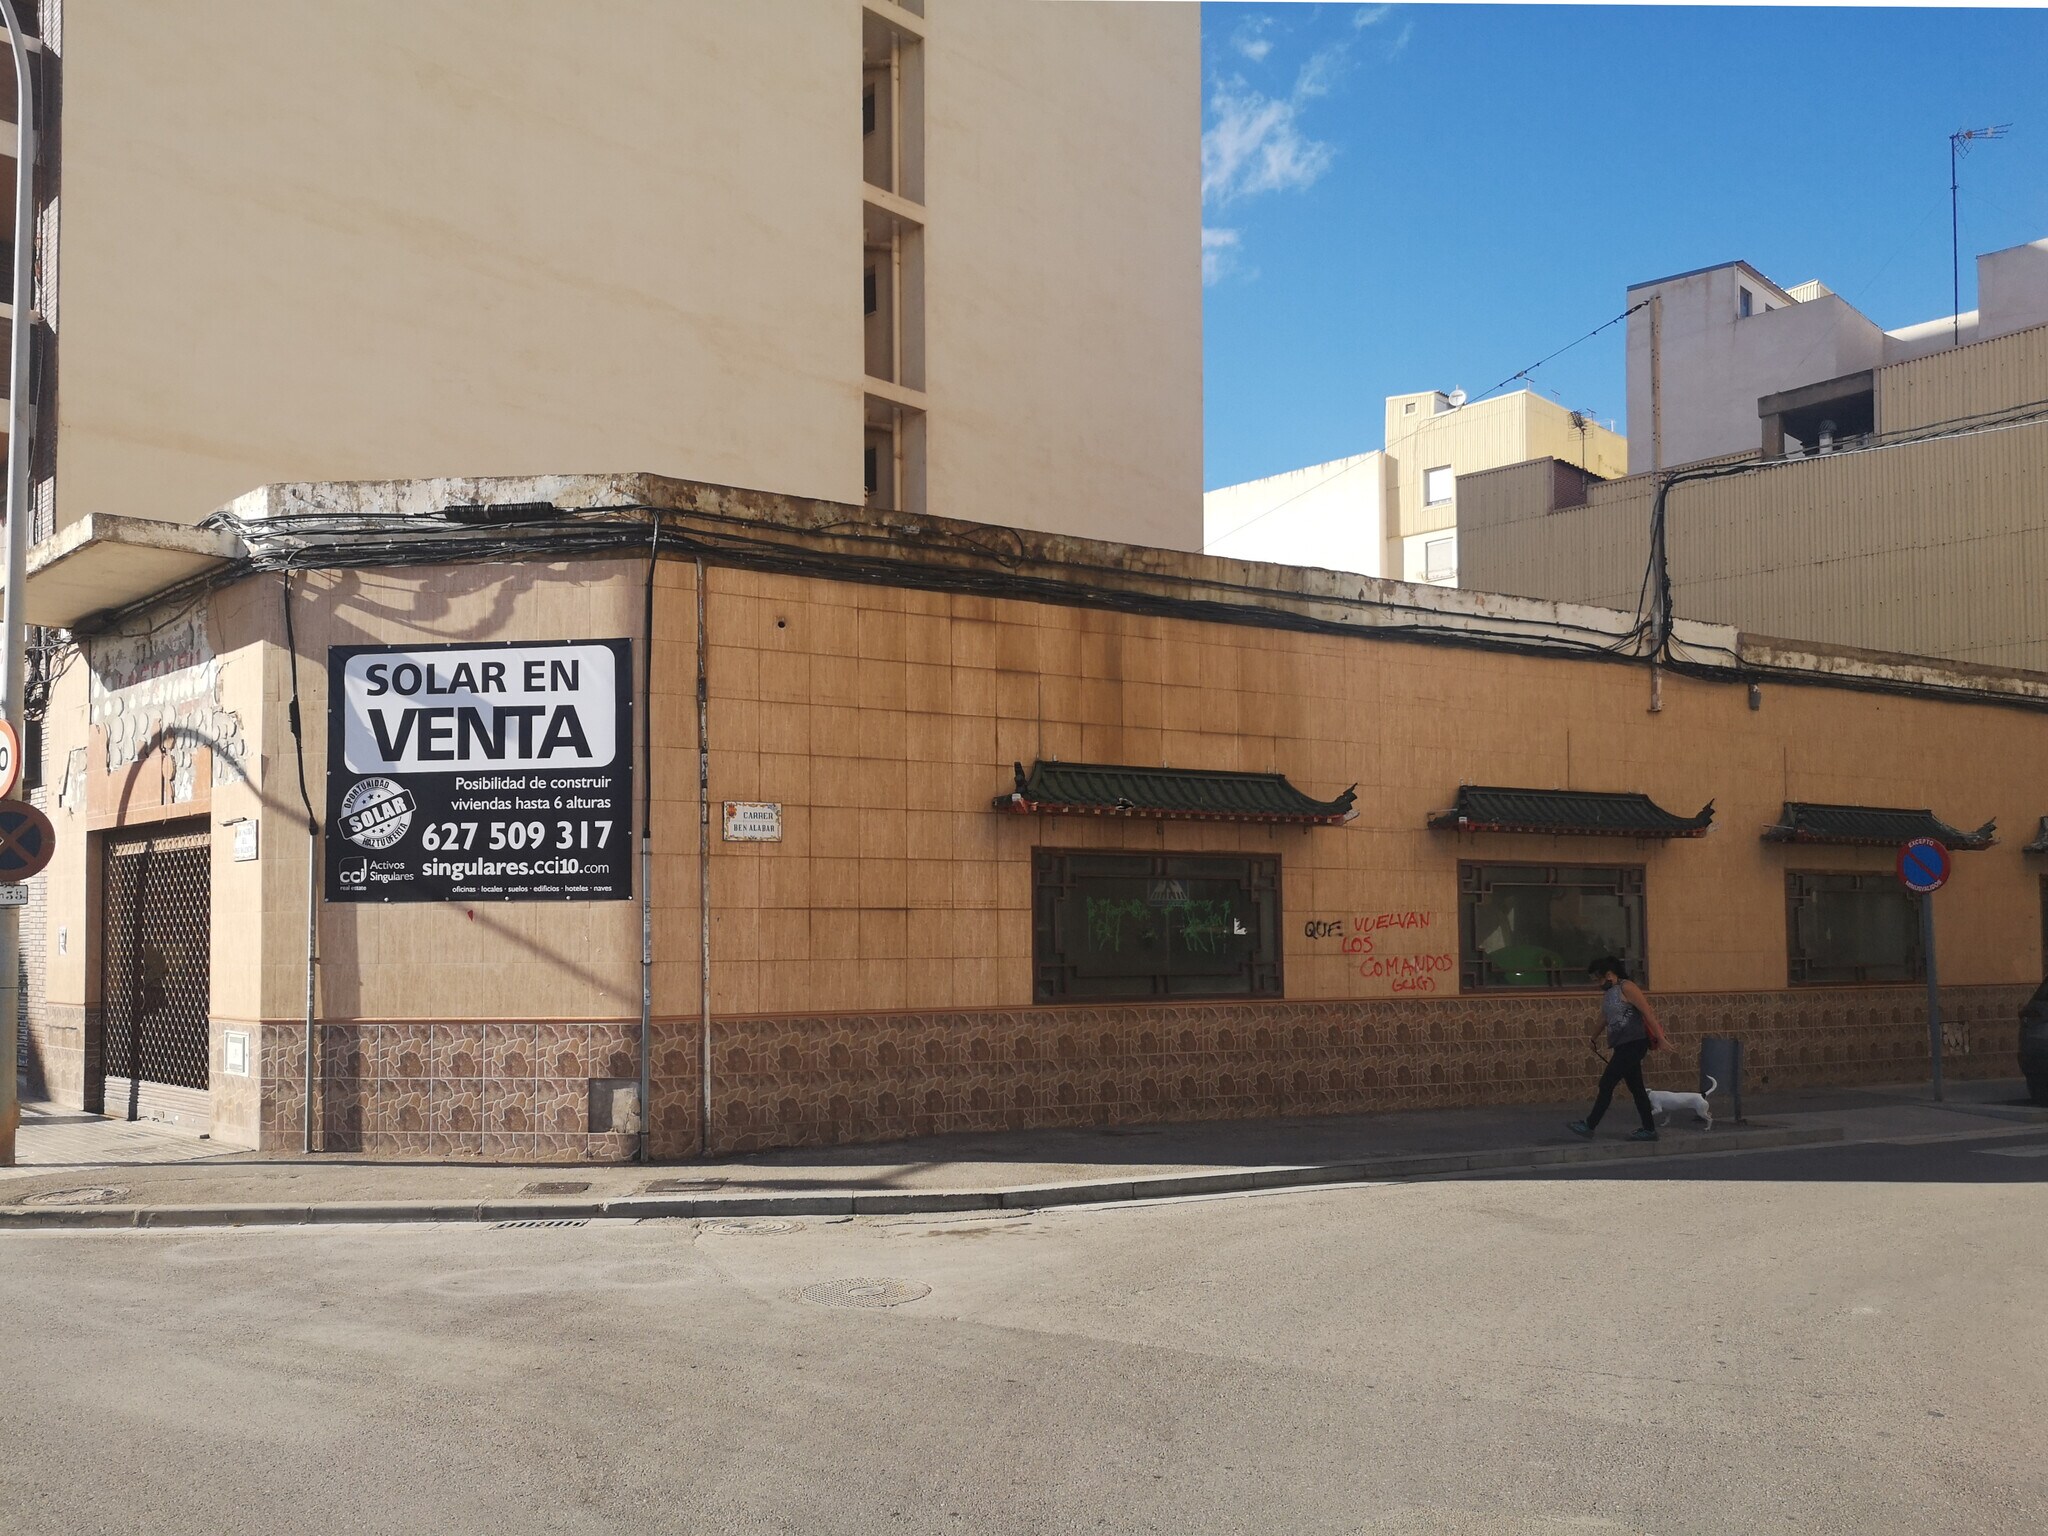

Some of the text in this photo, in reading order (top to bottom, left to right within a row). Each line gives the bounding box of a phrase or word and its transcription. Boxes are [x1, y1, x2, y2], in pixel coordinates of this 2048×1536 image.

[366, 660, 579, 696] SOLAR EN
[367, 705, 593, 762] VENTA
[455, 776, 612, 790] Posibilidad de construir
[344, 780, 389, 809] OPORTUNIDAD
[451, 796, 611, 810] viviendas hasta 6 alturas
[349, 797, 407, 833] SOLAR
[743, 812, 774, 820] CARRER
[422, 820, 613, 851] 627 509 317
[1908, 839, 1934, 848] EXCEPTO
[370, 860, 405, 870] Activos
[370, 871, 414, 884] Singulares
[452, 885, 476, 893] oficinas
[481, 885, 503, 893] locales
[1354, 911, 1431, 932] VUELVAN
[1341, 936, 1374, 953] LOS
[1360, 954, 1453, 977] COMANDOS
